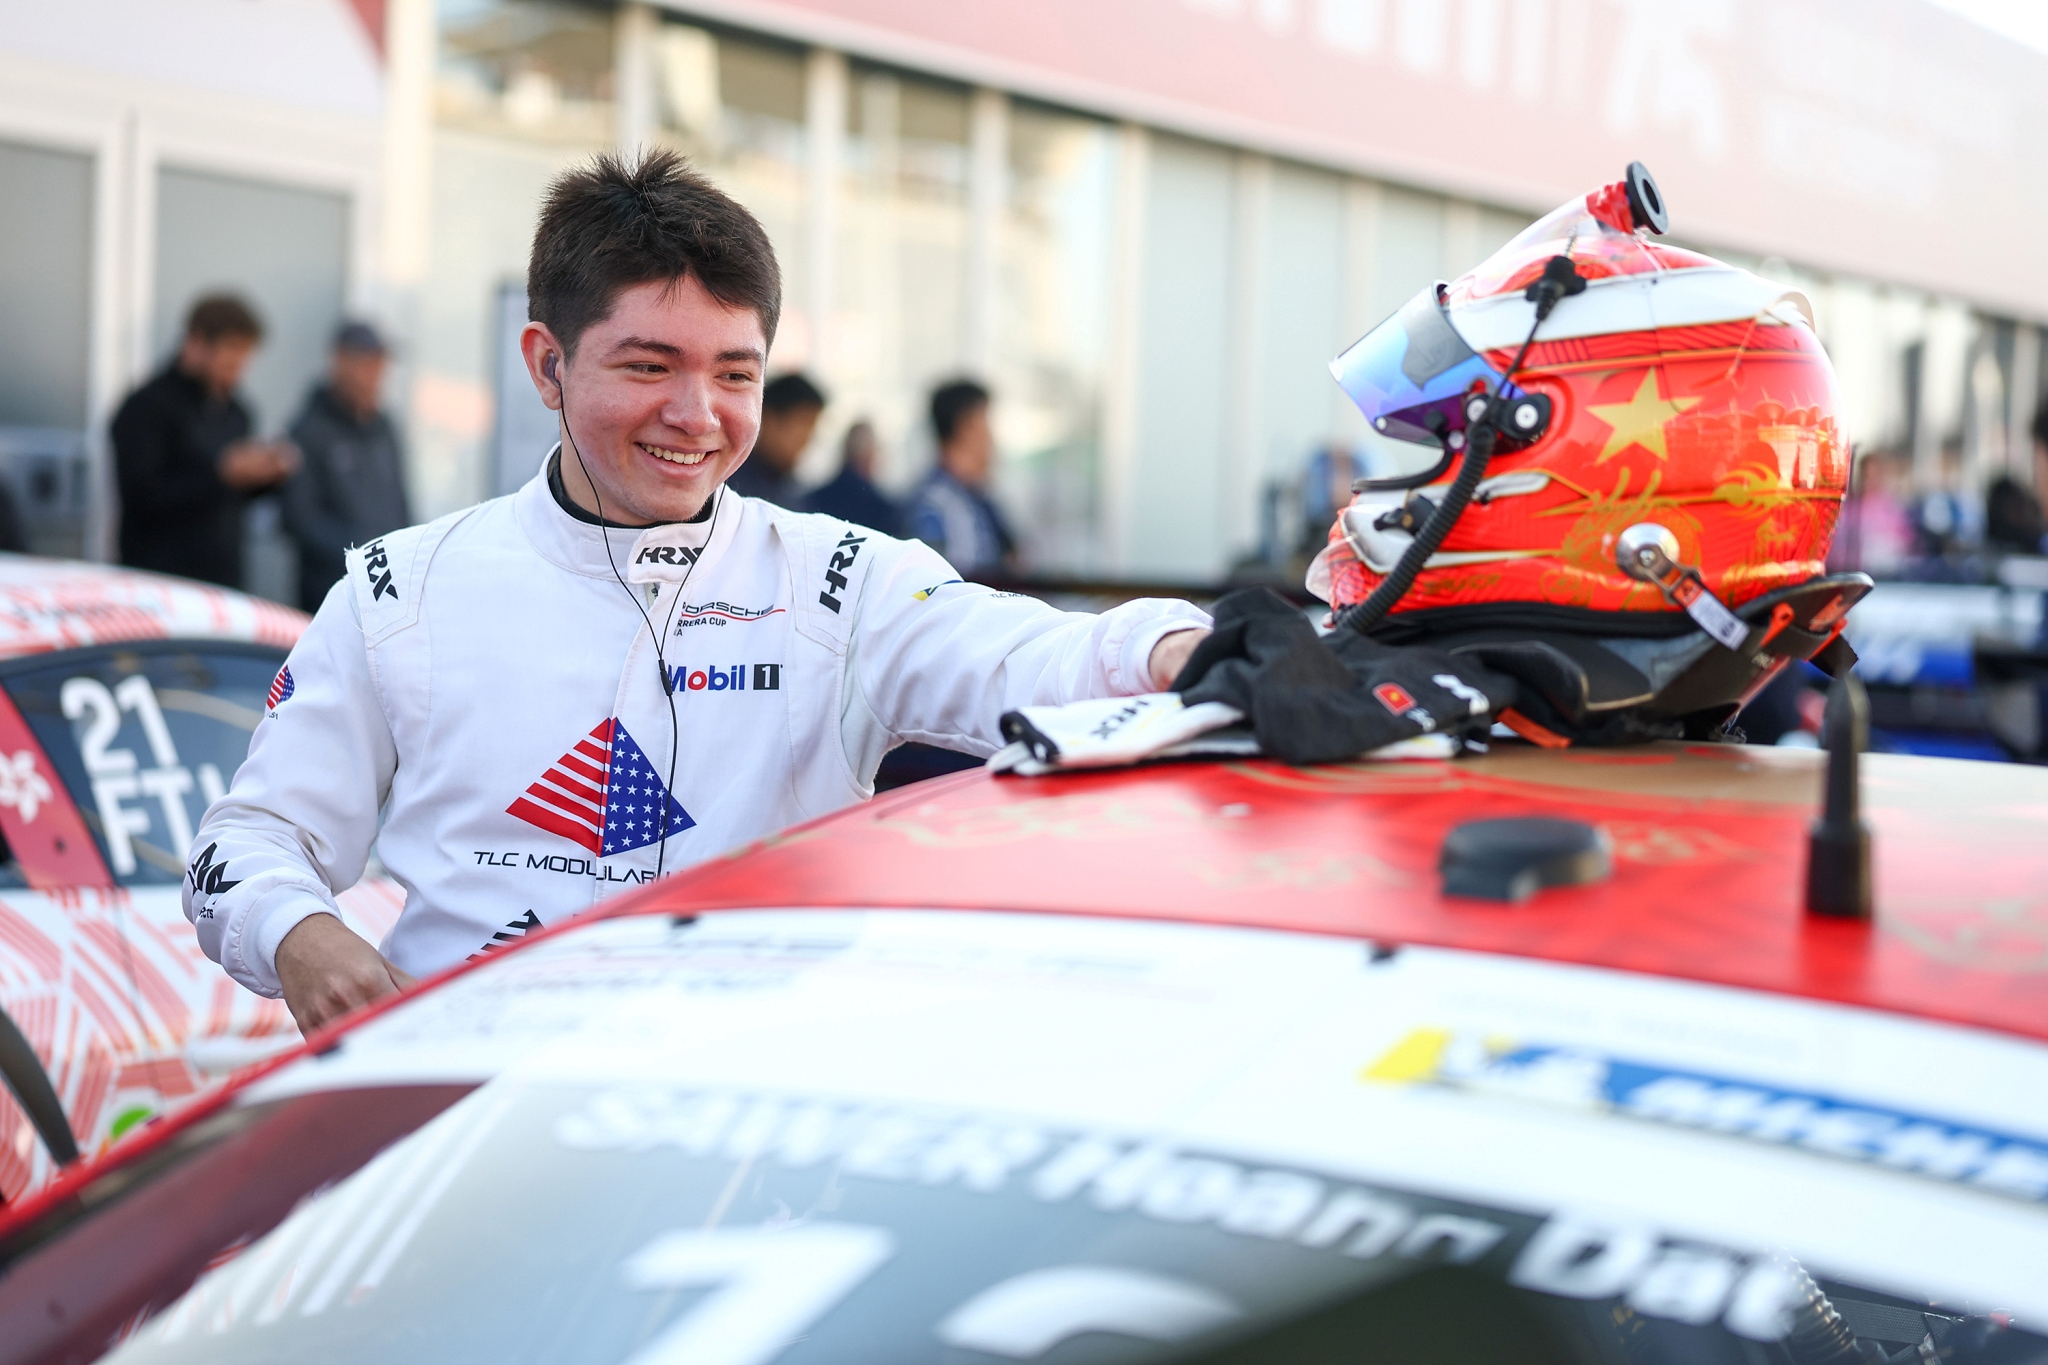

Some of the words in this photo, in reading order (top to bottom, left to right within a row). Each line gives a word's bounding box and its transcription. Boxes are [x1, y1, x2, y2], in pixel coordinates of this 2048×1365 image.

[364, 539, 399, 602] HRX
[636, 546, 704, 566] HRX
[819, 531, 867, 614] HRX
[709, 617, 727, 627] CUP
[668, 664, 746, 692] Mobil
[60, 674, 181, 774] 21
[474, 851, 519, 867] TLC
[526, 854, 656, 884] MODULAR
[1510, 1208, 1800, 1342] Dat
